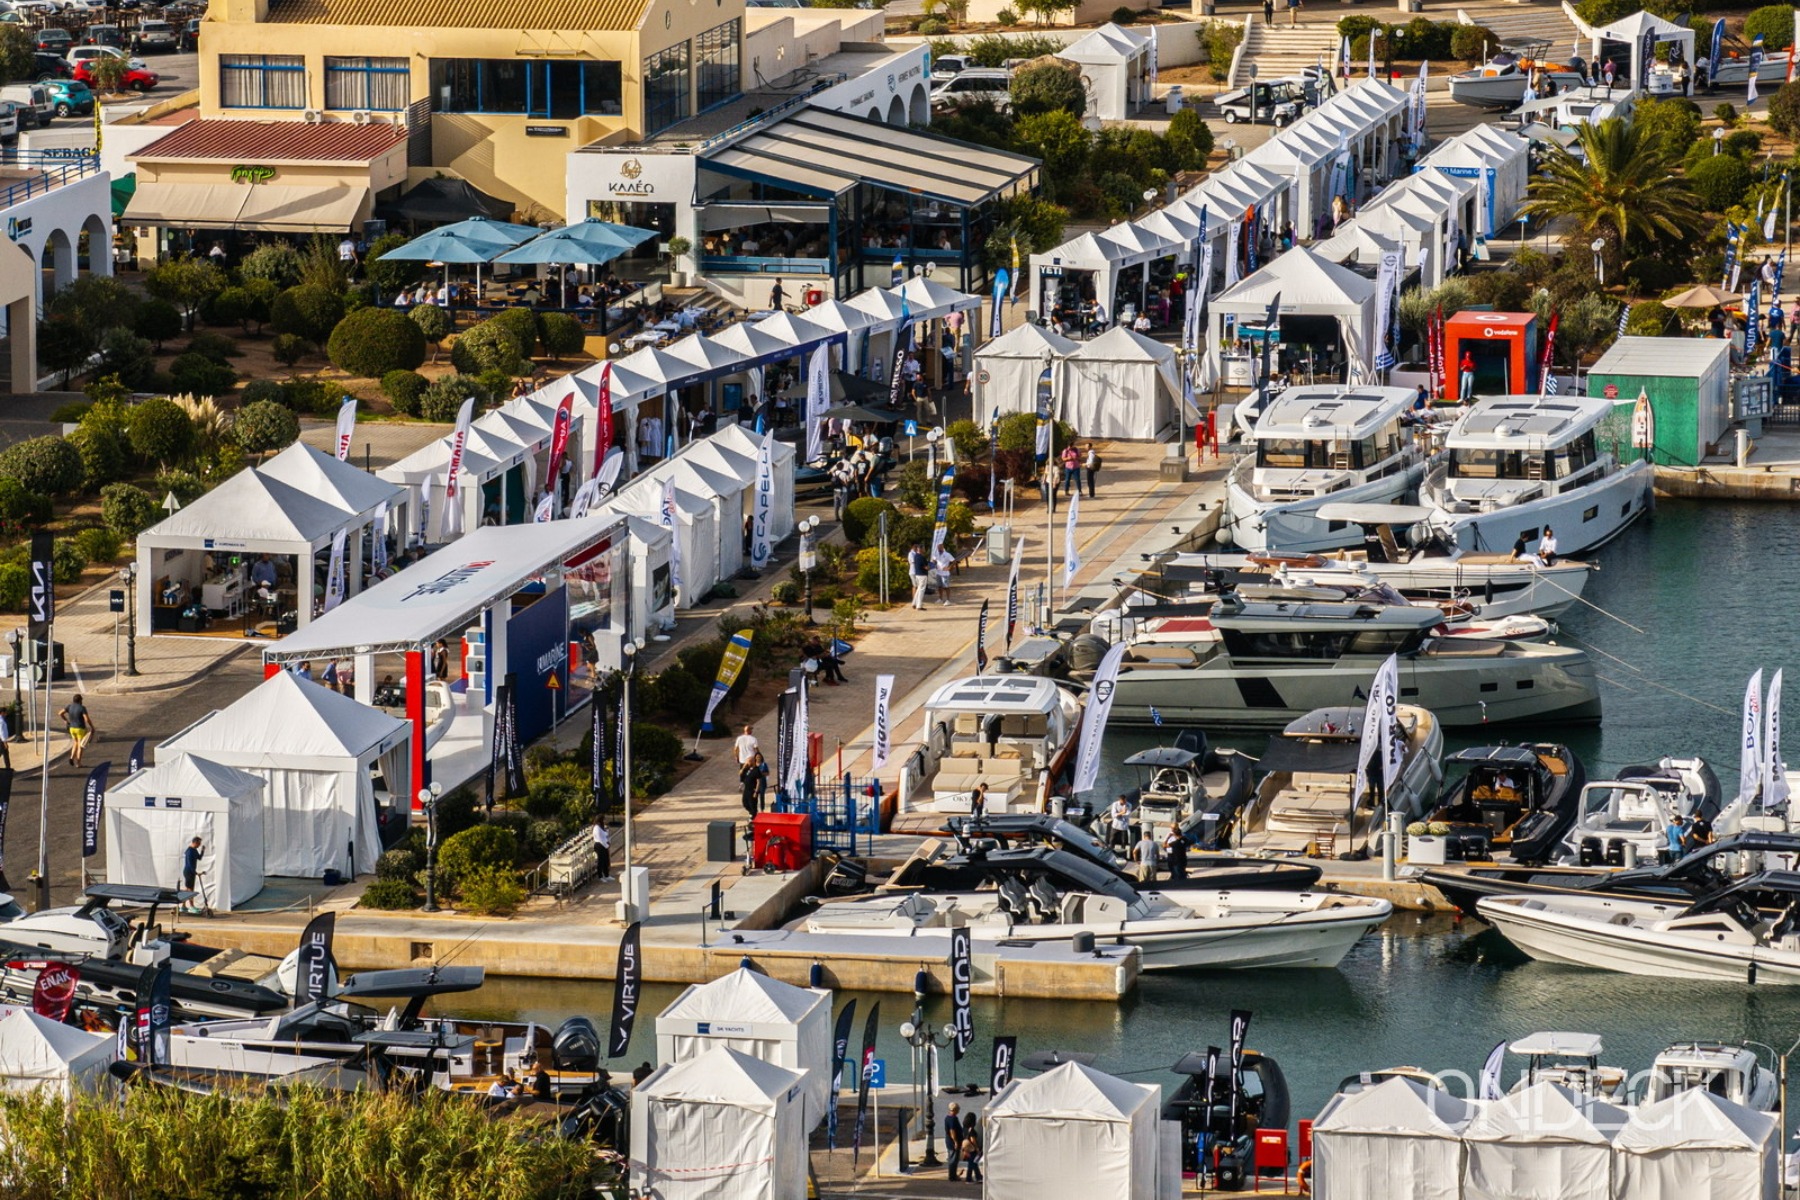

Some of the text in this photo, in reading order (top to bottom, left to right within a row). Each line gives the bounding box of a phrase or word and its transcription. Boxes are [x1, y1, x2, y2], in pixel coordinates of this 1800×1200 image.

[43, 147, 98, 158] SEBAG
[1040, 265, 1062, 275] YETI
[450, 430, 464, 481] YAMAHA
[756, 446, 770, 538] CAPELLI
[86, 778, 97, 847] DOCKSIDES
[40, 969, 71, 991] ENAK
[621, 943, 635, 1022] VIRTUE
